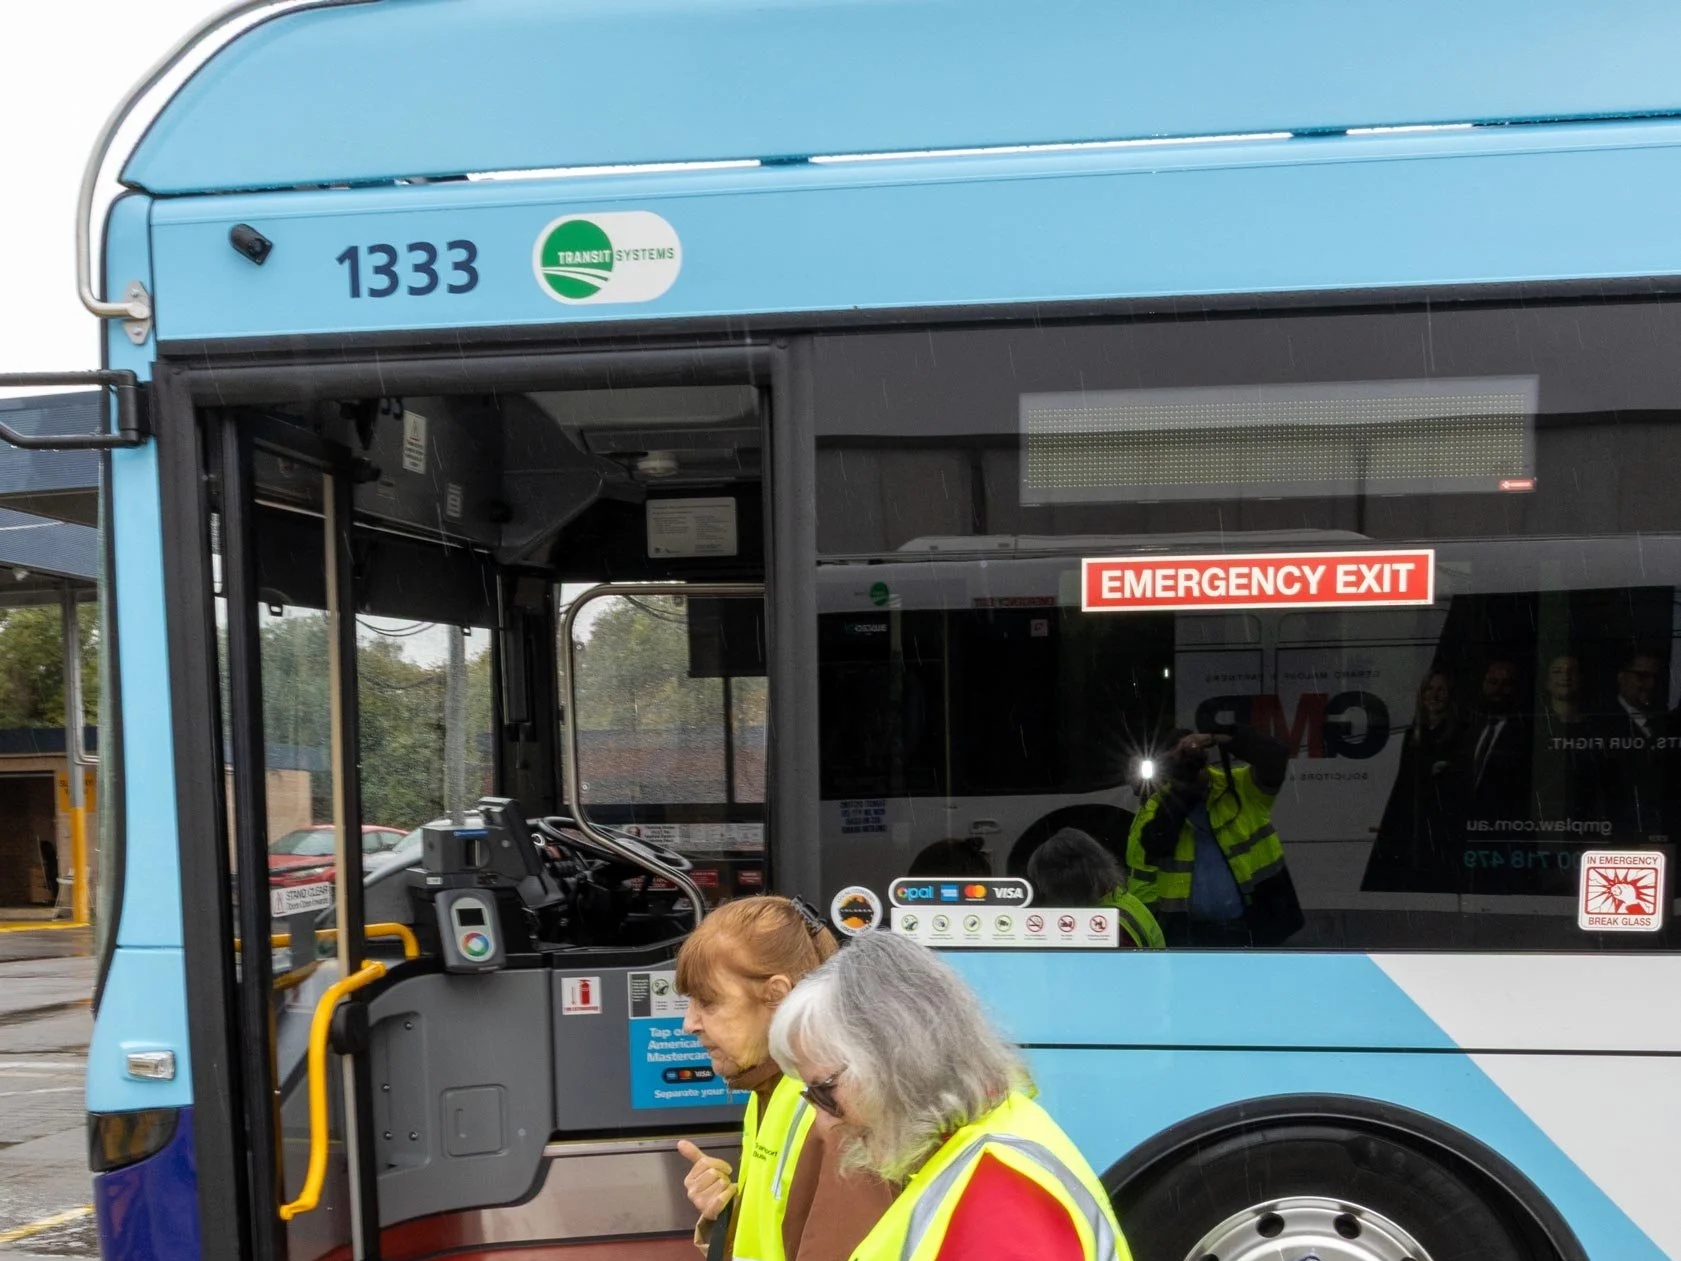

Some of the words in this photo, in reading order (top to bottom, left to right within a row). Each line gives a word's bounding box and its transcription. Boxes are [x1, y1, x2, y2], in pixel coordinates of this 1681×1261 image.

[557, 250, 611, 265] TRANSIT
[615, 247, 675, 262] SYSTEMS
[335, 239, 480, 299] 1333
[1101, 564, 1327, 600] EMERGENCY
[1335, 562, 1416, 594] EXIT
[1587, 856, 1597, 865] IN
[1599, 856, 1659, 865] EMERGENCY
[896, 885, 935, 902] opal
[992, 887, 1024, 899] VISA
[1588, 917, 1619, 926] BREAK
[1621, 917, 1652, 926] GLASS
[649, 1027, 672, 1039] Tap
[654, 1088, 700, 1099] Separate
[701, 1088, 725, 1098] your
